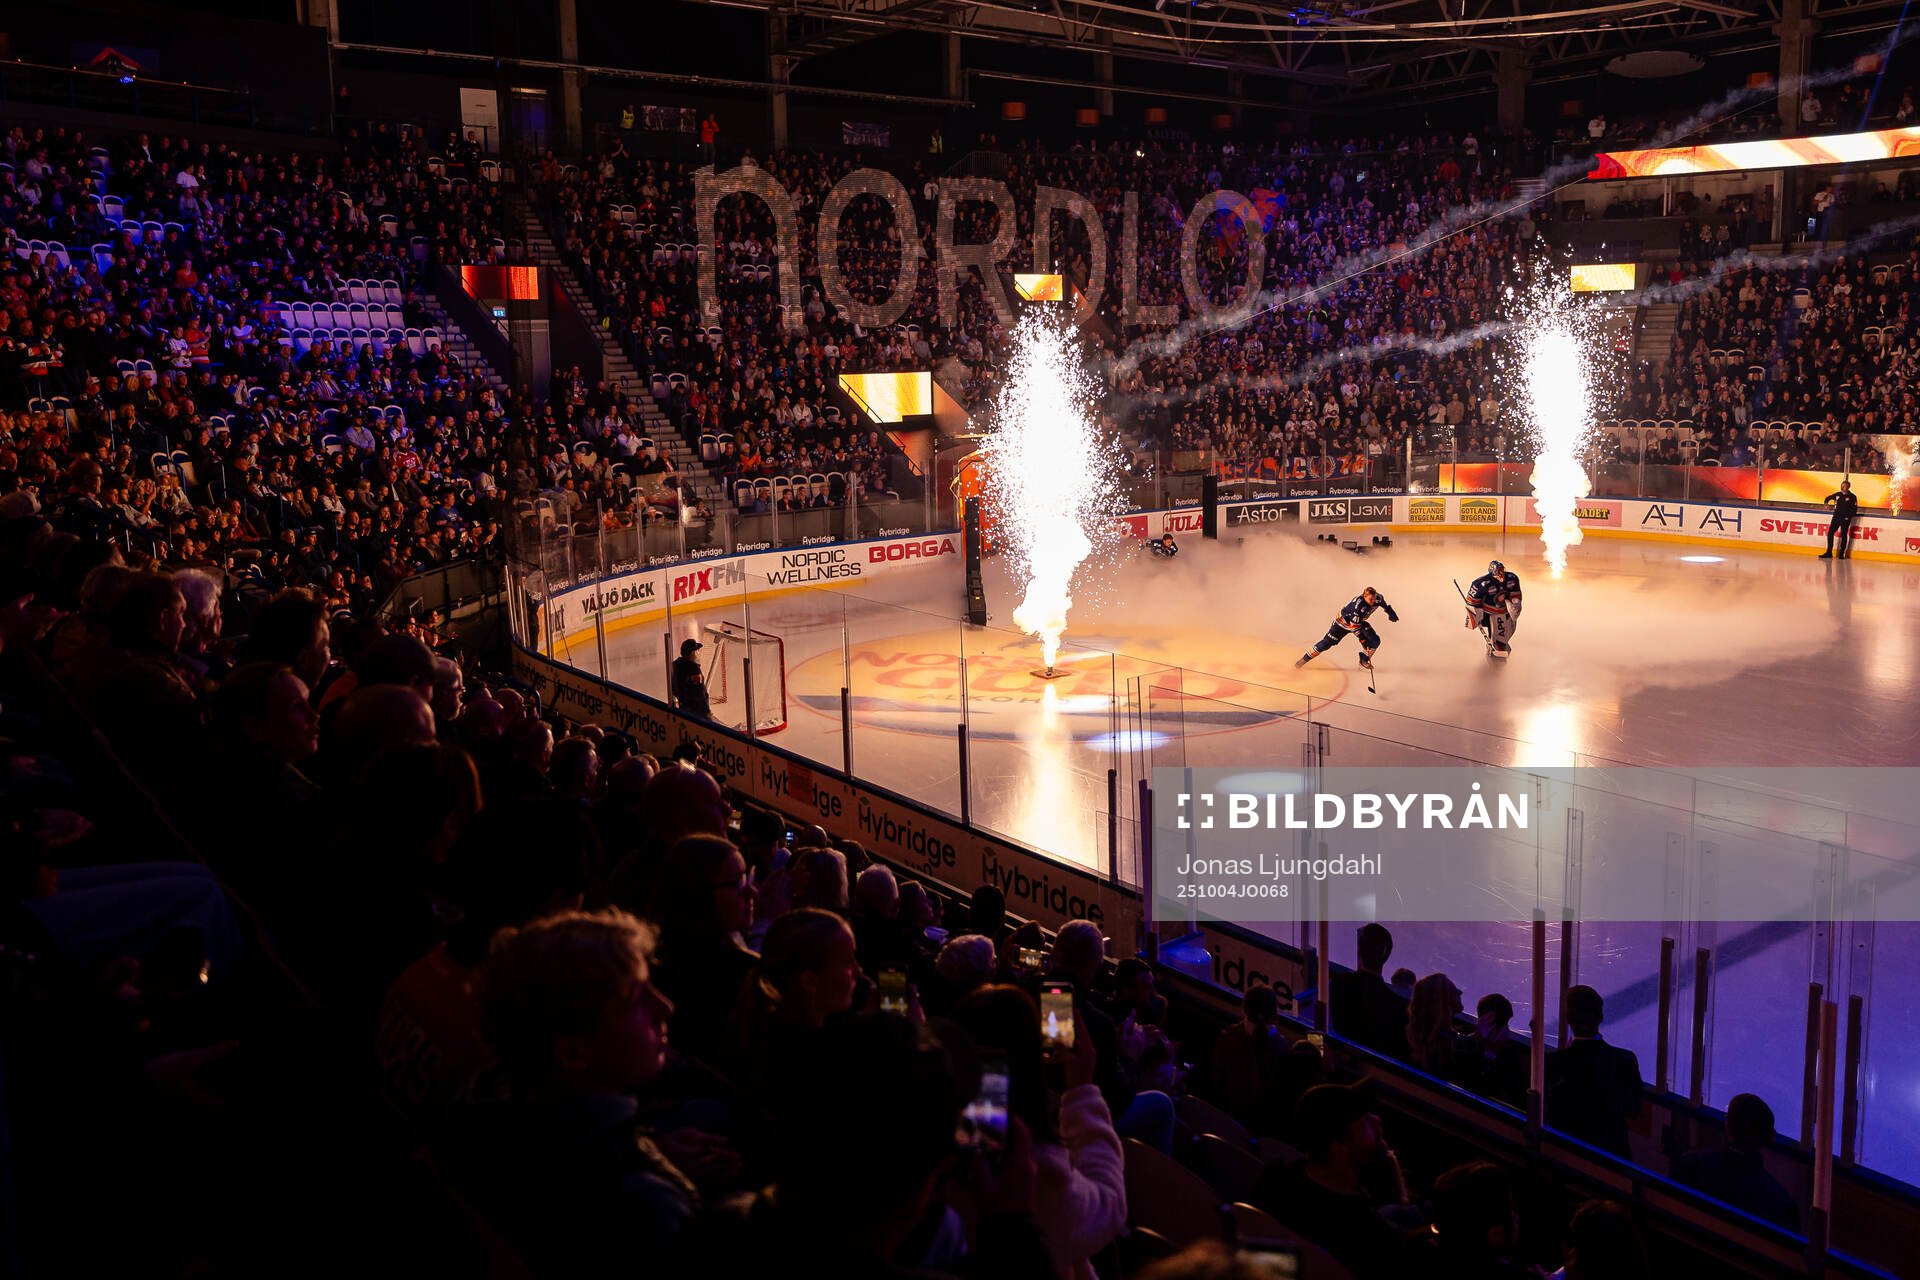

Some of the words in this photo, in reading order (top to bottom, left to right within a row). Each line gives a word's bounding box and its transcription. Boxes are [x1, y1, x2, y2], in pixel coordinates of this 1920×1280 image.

[1237, 505, 1287, 524] Astor
[1311, 503, 1346, 517] JKS
[1760, 518, 1879, 541] SVETRCK
[782, 549, 846, 569] NORDIC
[869, 538, 956, 563] BORGA
[767, 562, 861, 585] WELLNESS
[582, 587, 619, 614] VÄXJÖ
[621, 581, 656, 603] DÄCK
[858, 801, 956, 868] Hybridge
